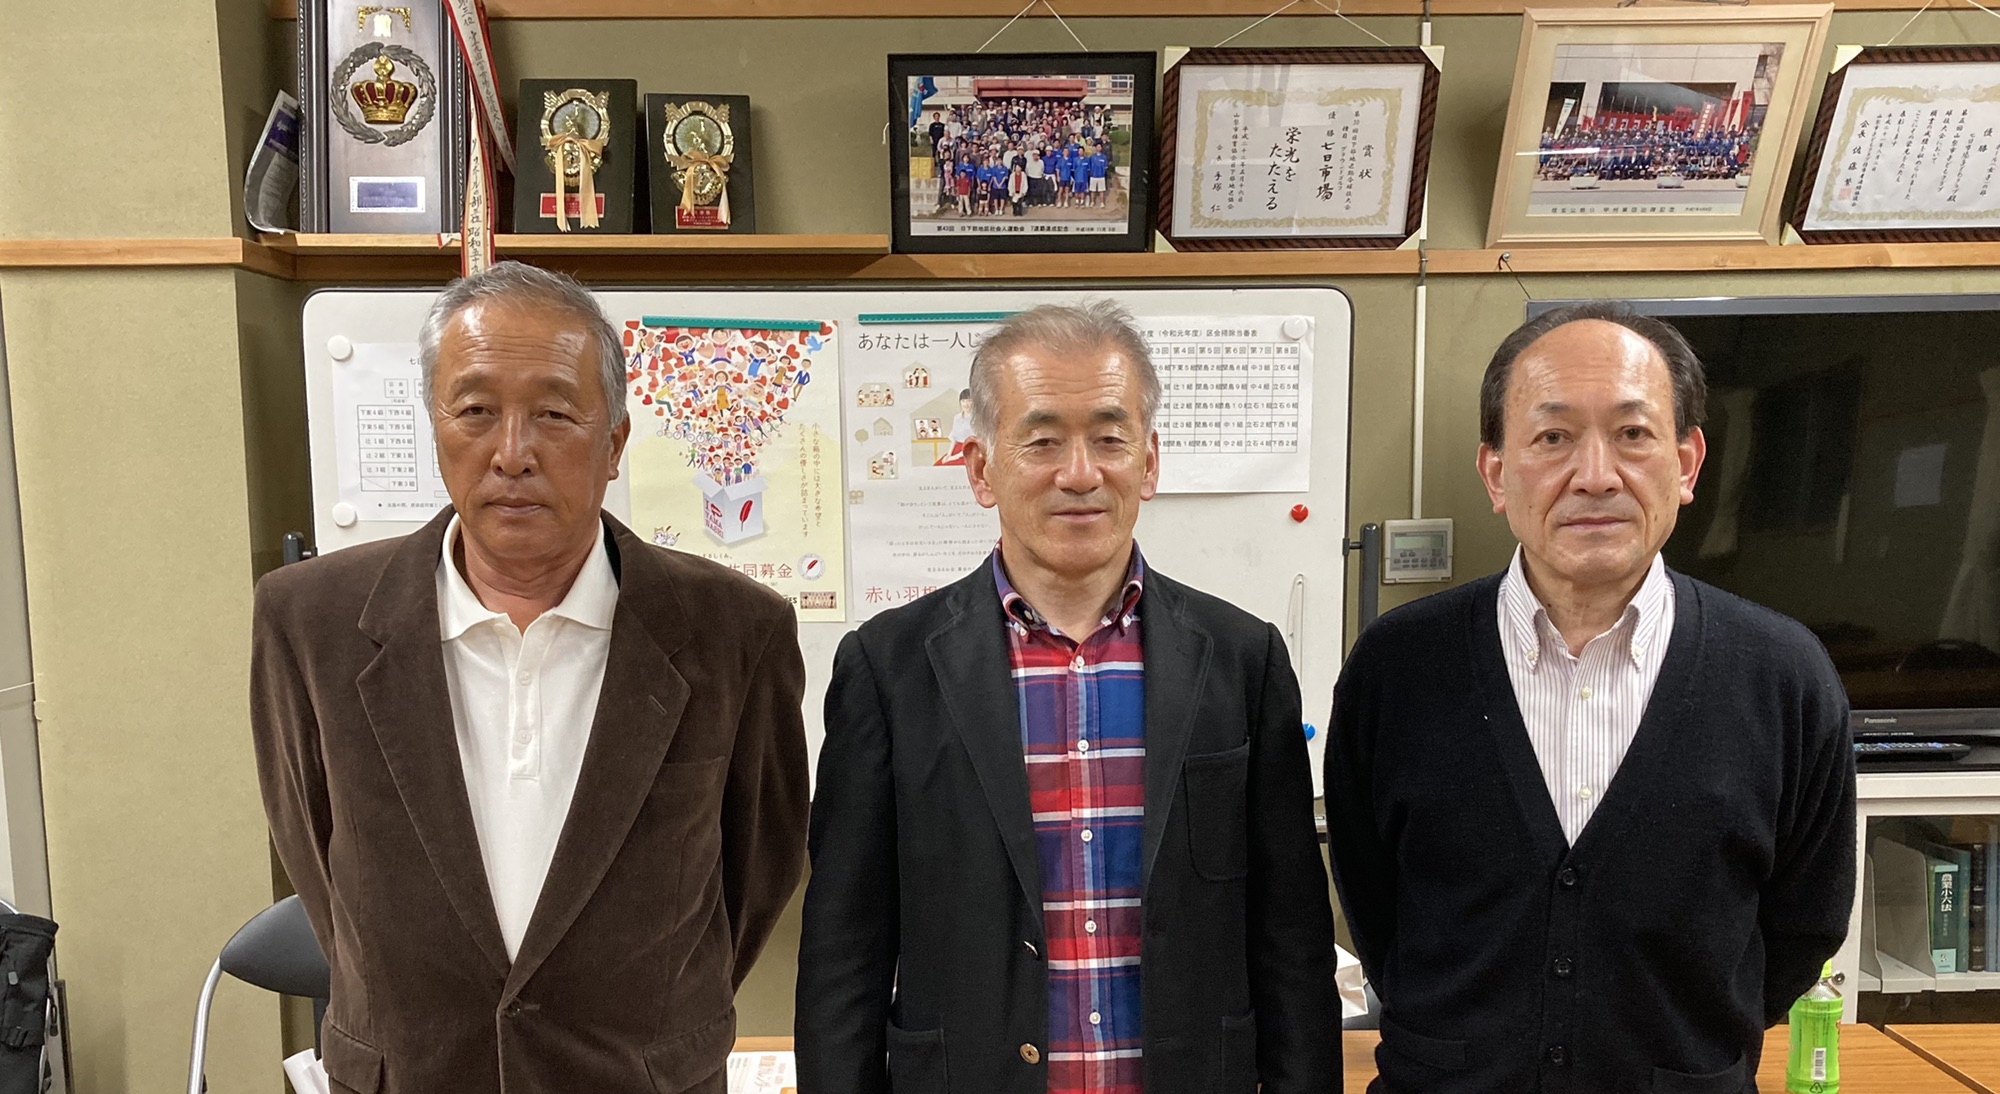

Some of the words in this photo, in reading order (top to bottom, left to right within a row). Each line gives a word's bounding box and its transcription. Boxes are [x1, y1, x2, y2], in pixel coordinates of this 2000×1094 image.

[1857, 119, 1870, 139] 会長
[1978, 127, 1994, 153] 優勝
[1282, 126, 1302, 182] 栄光を
[1358, 144, 1375, 180] 賞状
[1265, 142, 1283, 211] たたえる
[1315, 141, 1336, 203] 七日市場
[858, 331, 981, 351] あなたは一人じ
[1173, 346, 1195, 354] 第4回
[1199, 346, 1221, 354] 第5回
[1224, 346, 1247, 354] 第6回
[1250, 346, 1272, 354] 第7回
[1276, 346, 1298, 354] 第8回
[1940, 873, 1953, 913] 農業小六法
